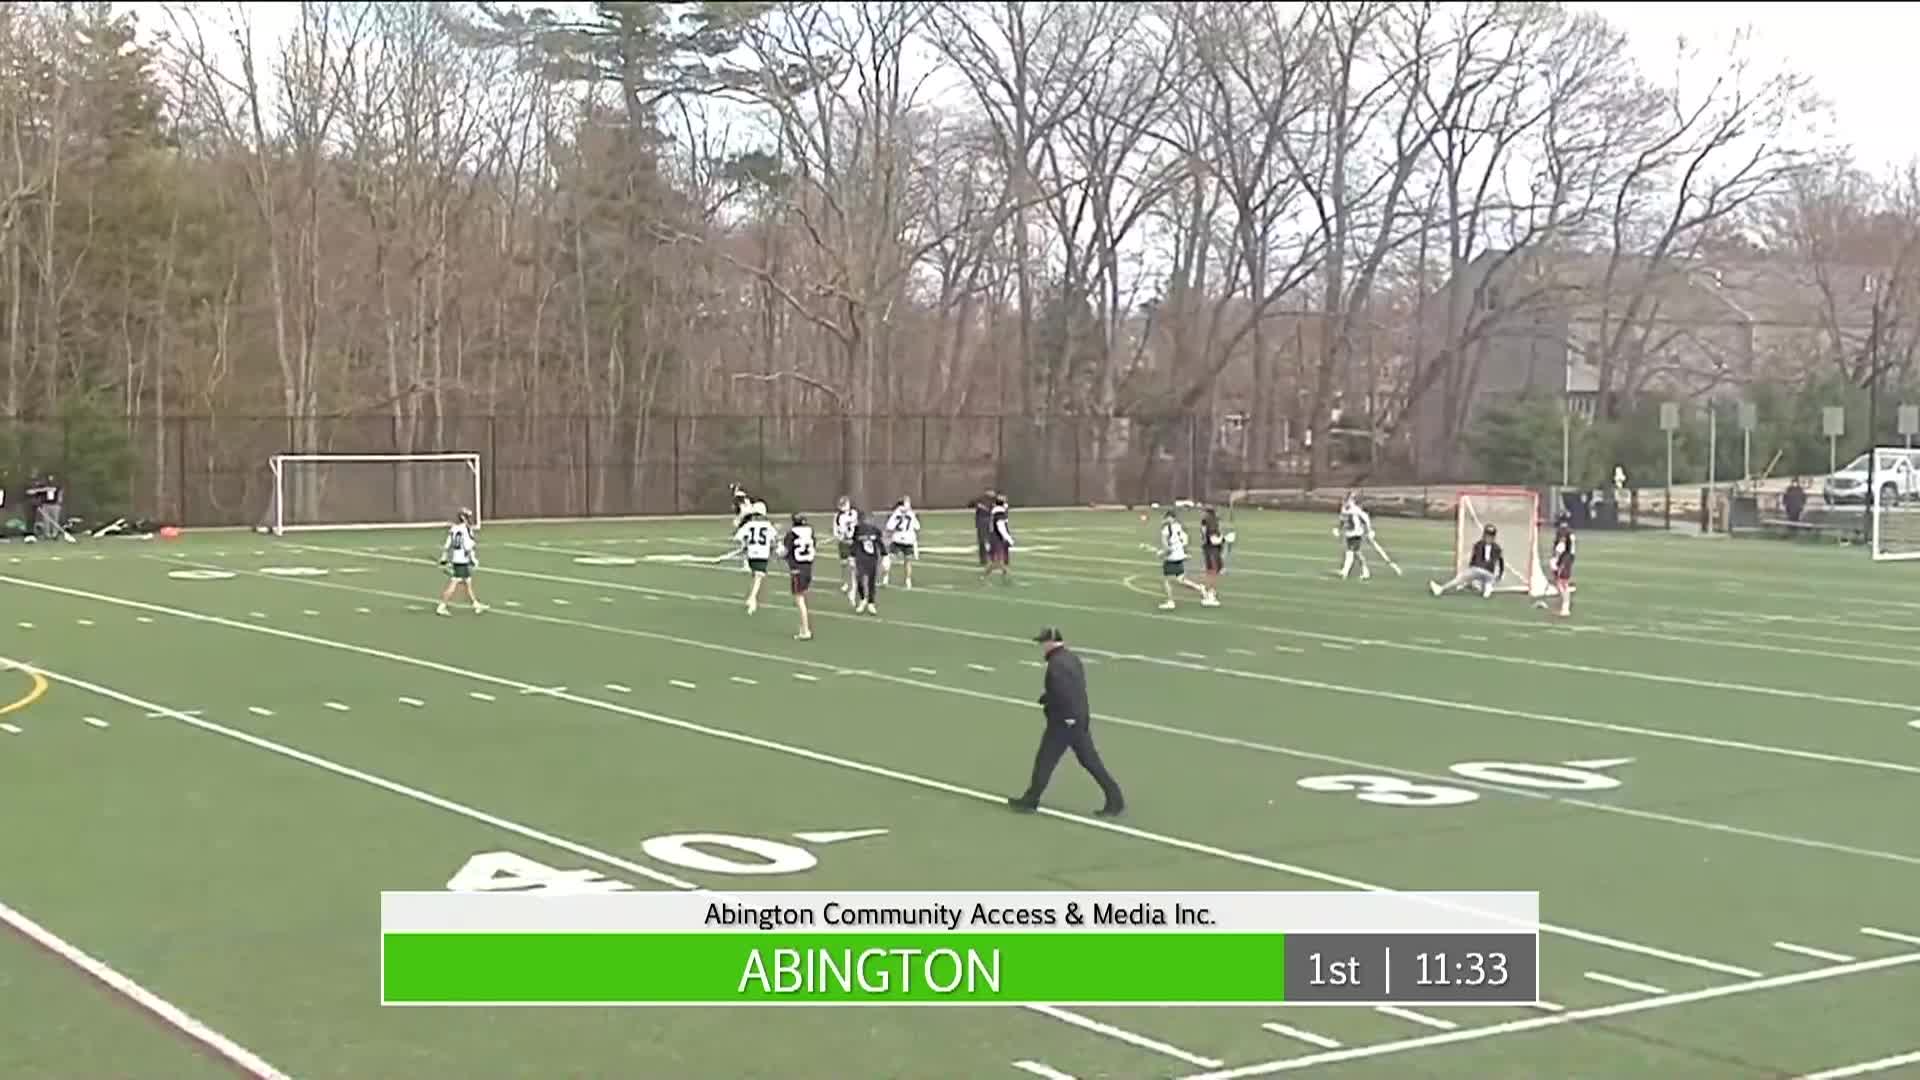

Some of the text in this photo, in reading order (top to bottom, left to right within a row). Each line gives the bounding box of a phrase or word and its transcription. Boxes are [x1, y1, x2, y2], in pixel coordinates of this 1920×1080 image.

[894, 514, 912, 532] 27
[749, 526, 768, 546] 15
[1296, 760, 1623, 806] 30
